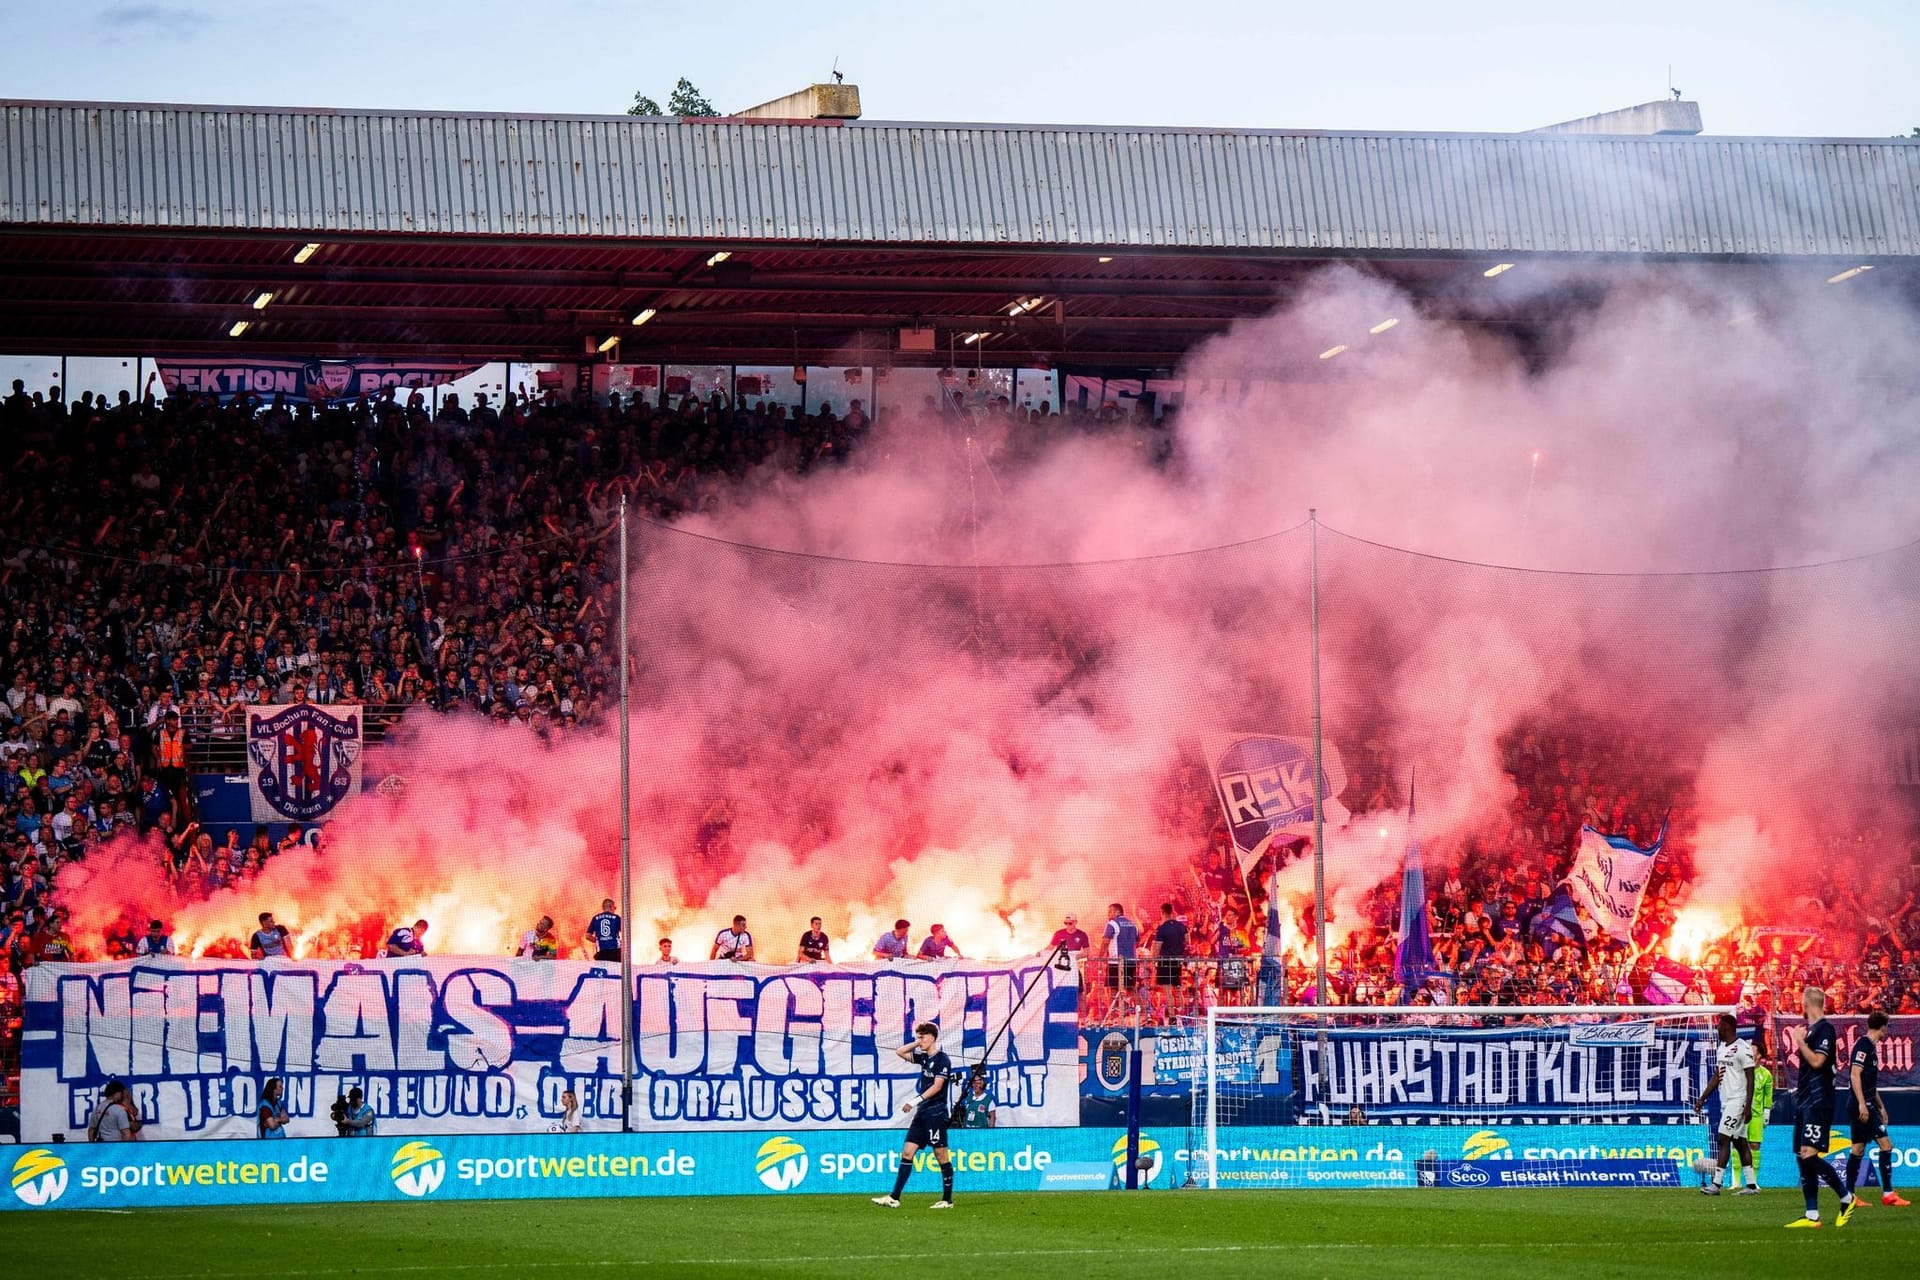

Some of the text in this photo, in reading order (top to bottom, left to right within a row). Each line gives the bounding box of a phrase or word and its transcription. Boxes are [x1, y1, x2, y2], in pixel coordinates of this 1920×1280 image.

[161, 368, 297, 393] SEKTION
[257, 724, 272, 734] VfL
[273, 709, 309, 731] Bochum
[311, 711, 329, 727] Fan
[334, 724, 354, 735] Club
[262, 778, 274, 787] 19
[1220, 761, 1314, 825] RSK
[600, 919, 611, 937] 6
[58, 967, 516, 1077] NIEMALS
[1576, 1026, 1623, 1040] Block
[1301, 1039, 1719, 1103] RUHRSTADTKOLLEKT
[70, 1079, 159, 1129] FR
[651, 1074, 894, 1122] DRAUSSEN
[1723, 1115, 1738, 1128] 22
[929, 1129, 941, 1141] 14
[1804, 1123, 1823, 1140] 33
[81, 1155, 328, 1193] sportwetten.de
[458, 1149, 696, 1186] sportwetten.de
[1184, 1168, 1289, 1182] spotwetten.de
[1307, 1169, 1406, 1182] sportwetten.de
[1500, 1170, 1670, 1182] Eiskalt hinterm Tor
[1045, 1172, 1107, 1182] sportwetten.de
[1451, 1171, 1488, 1183] Seco
